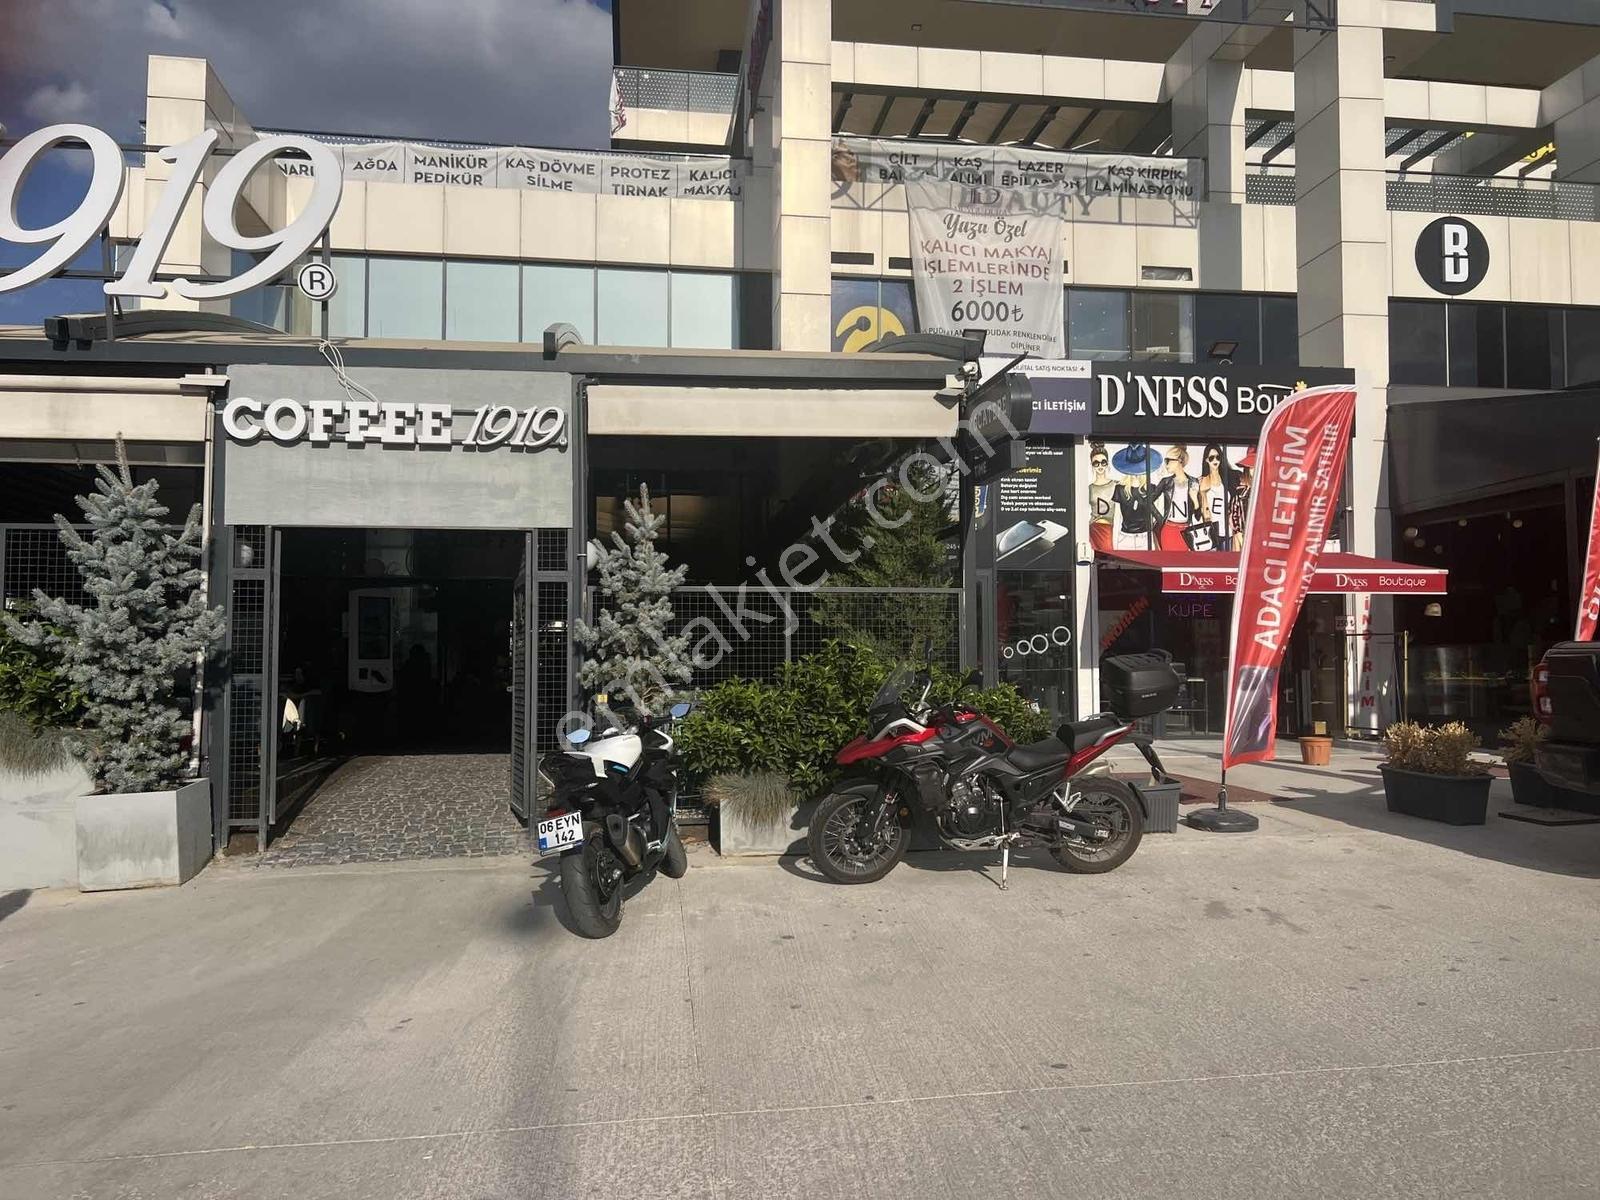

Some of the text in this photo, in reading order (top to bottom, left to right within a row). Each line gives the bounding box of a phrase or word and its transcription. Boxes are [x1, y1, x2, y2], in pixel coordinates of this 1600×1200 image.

[352, 158, 398, 171] AĞDA
[414, 153, 489, 170] MANİKÜR
[888, 150, 921, 166] CİLT
[954, 157, 983, 171] KAŞ
[1018, 159, 1064, 174] LAZER
[505, 158, 596, 176] KAŞ DÖVME
[610, 166, 671, 181] PROTEZ
[689, 168, 737, 182] KALICI
[1107, 164, 1184, 180] KAŞ KİRPİK
[414, 171, 483, 187] PEDİKÜR
[526, 174, 573, 192] SİLME
[611, 183, 669, 198] TIRNAK
[683, 183, 741, 197] MAKYAJ
[1094, 179, 1194, 197] LAMİNASYONU
[993, 217, 1028, 243] Özel
[920, 239, 976, 257] KALICI
[923, 257, 1050, 281] İŞLEMLERİNDE
[952, 275, 1024, 298] 2 İŞLEM
[1098, 371, 1229, 418] D'NESS
[1043, 398, 1086, 413] İLETİŞİM
[222, 397, 451, 445] COFFEE
[1314, 423, 1339, 491] SATILIR
[1305, 494, 1327, 557] ALINIR
[1254, 425, 1310, 650] ADACI İLETİŞİM
[1378, 575, 1427, 588] Boutique
[540, 813, 580, 835] 06 EYN
[555, 829, 576, 845] 142
